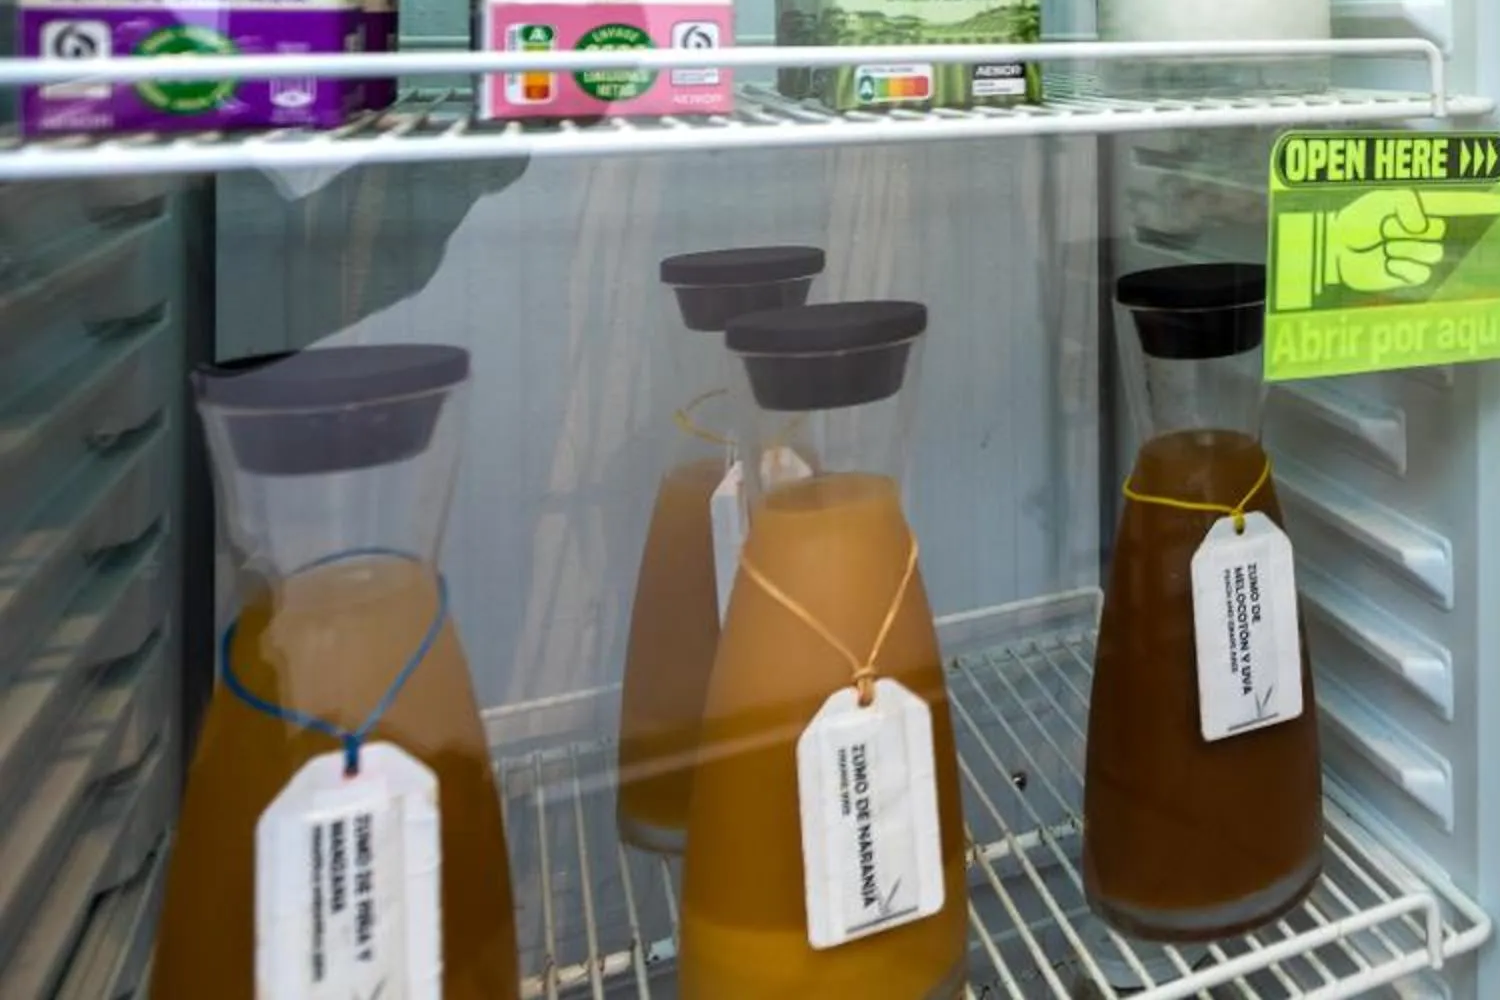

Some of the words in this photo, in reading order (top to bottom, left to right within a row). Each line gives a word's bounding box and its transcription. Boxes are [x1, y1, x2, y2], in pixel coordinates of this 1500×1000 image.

[1285, 139, 1365, 181] OPEN
[1375, 138, 1448, 179] HERE
[1272, 316, 1364, 364] Abrir
[1371, 319, 1431, 364] por
[1248, 564, 1259, 602] ZUMO
[1235, 567, 1250, 650] MELOCOTÓN
[1251, 605, 1261, 624] DE
[1242, 652, 1251, 663] Y
[1242, 665, 1253, 695] UVA
[852, 744, 868, 794] ZUMO
[856, 798, 870, 822] DE
